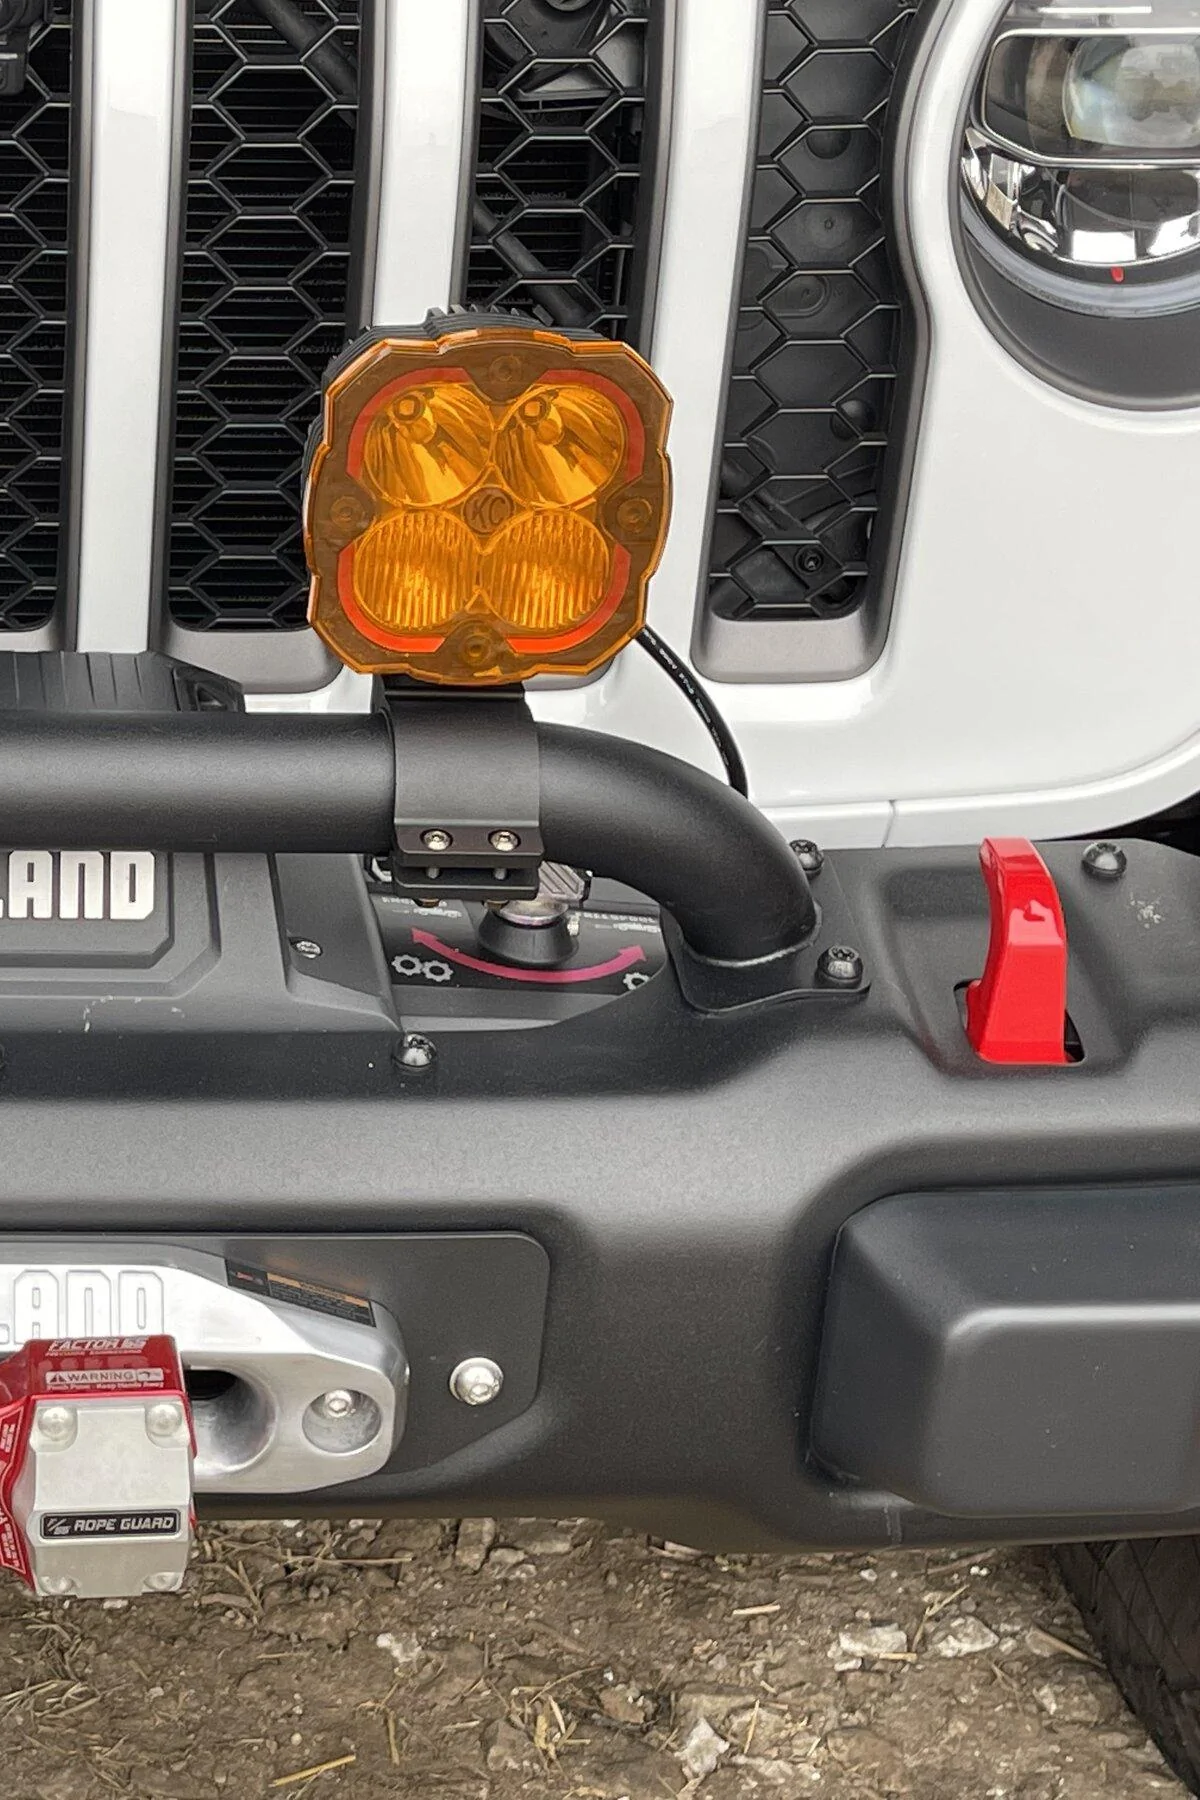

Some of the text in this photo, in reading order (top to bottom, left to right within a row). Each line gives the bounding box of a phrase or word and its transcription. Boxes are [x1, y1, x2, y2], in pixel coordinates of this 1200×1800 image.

[67, 1371, 134, 1382] WARNING
[74, 1518, 117, 1532] ROPE
[120, 1516, 175, 1530] GUARD
